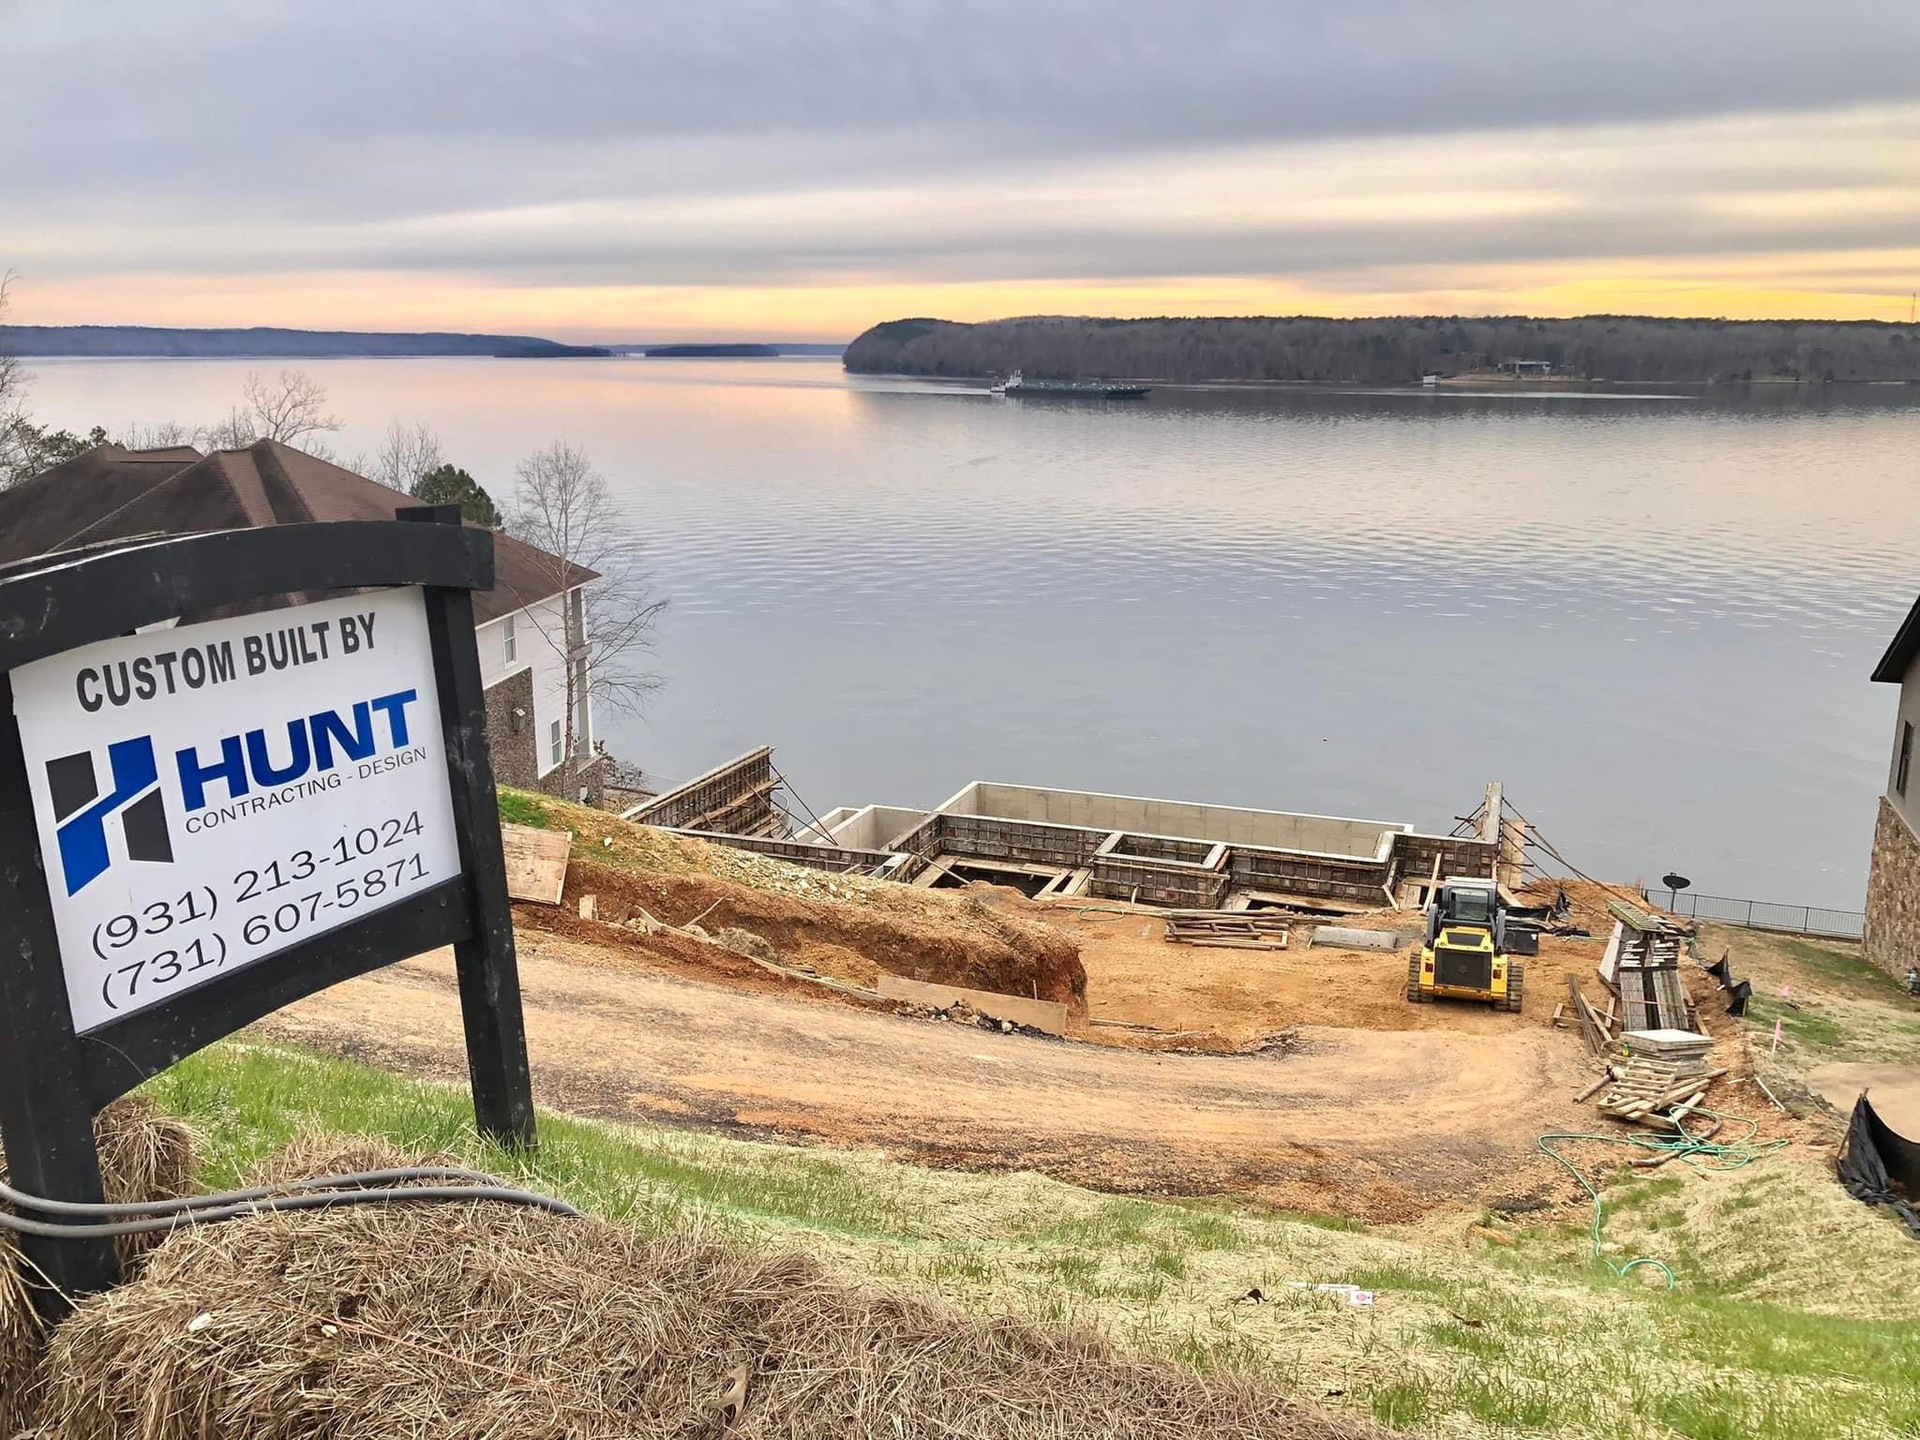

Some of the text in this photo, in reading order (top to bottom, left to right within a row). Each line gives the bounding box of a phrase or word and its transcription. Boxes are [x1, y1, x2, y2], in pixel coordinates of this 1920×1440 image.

[76, 612, 375, 712] CUSTOM BUILT BY
[175, 689, 417, 812] HUNT
[186, 774, 341, 833] CONTRACTING
[359, 747, 425, 779] DESIGN
[93, 811, 423, 960] (931) 213-1024
[103, 853, 429, 1009] (731) 607-5871
